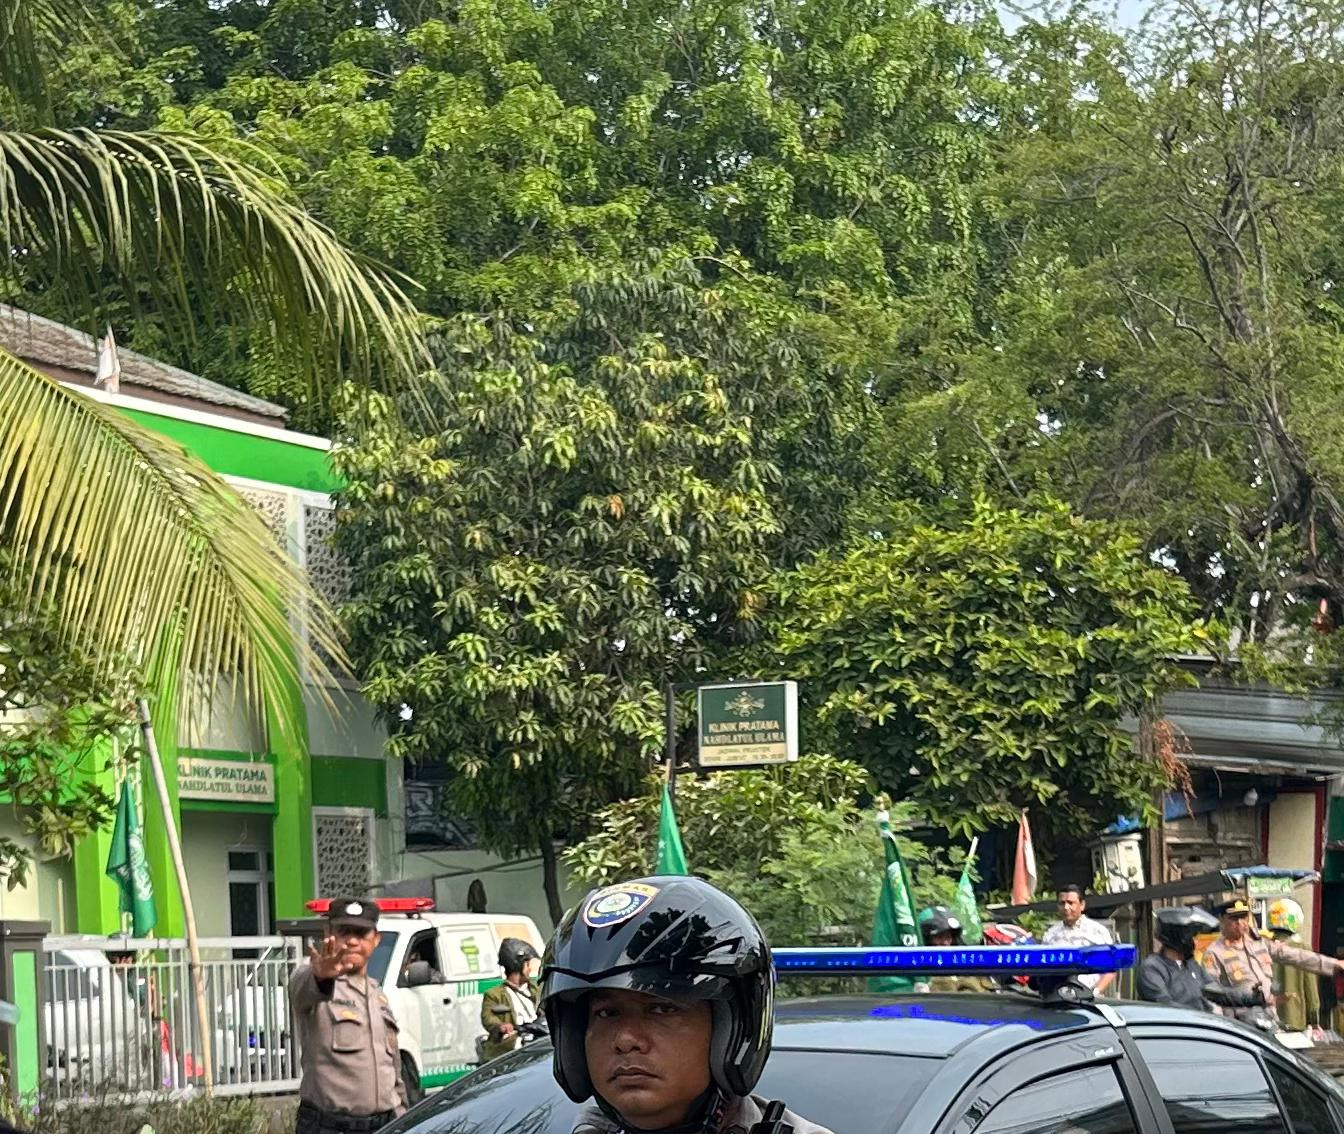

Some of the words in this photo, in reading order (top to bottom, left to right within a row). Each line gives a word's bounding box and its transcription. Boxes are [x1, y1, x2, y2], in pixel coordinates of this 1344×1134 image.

[739, 720, 779, 732] PRATAMA
[215, 767, 267, 781] PRATAMA
[236, 783, 268, 795] ULAMA
